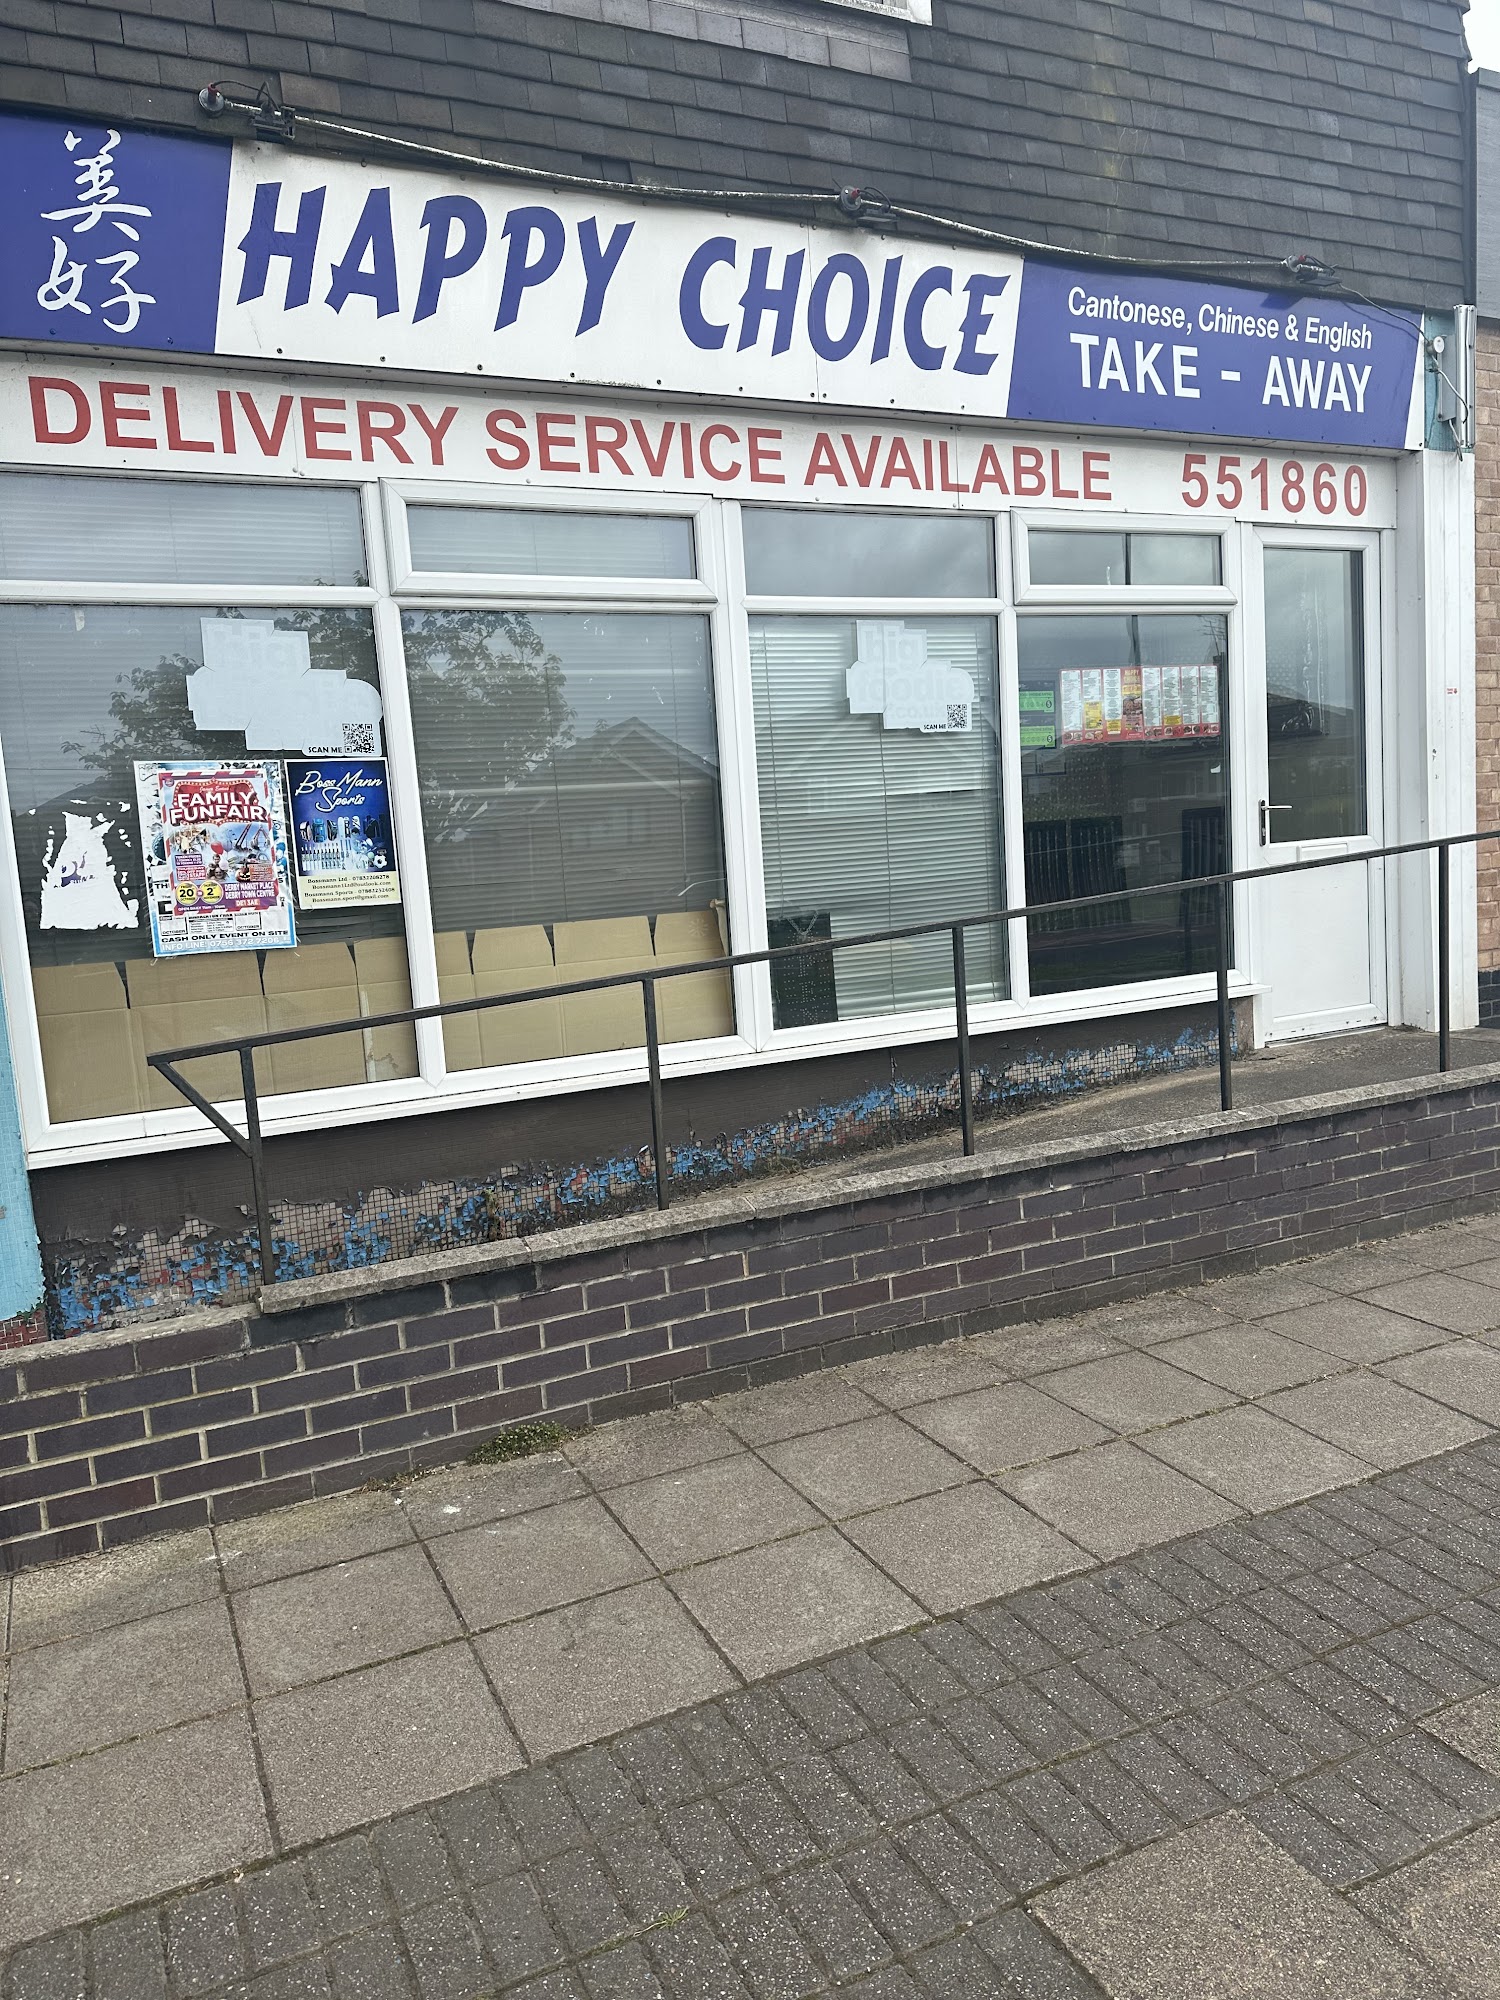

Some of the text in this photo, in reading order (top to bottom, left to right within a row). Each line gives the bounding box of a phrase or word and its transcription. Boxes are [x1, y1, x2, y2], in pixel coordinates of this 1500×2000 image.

[236, 181, 1011, 376] HAPPY CHOICE
[1068, 286, 1372, 353] Cantonese, Chinese & English
[1069, 332, 1201, 399] TAKE
[1261, 354, 1373, 413] AWAY
[27, 375, 1112, 501] DELIVERY SERVICE AVAILABLE
[1181, 453, 1368, 517] 551860
[308, 746, 343, 754] SCAN ME
[295, 769, 383, 796] Boss Mann
[177, 791, 255, 808] FAMILY
[315, 786, 366, 812] Sports
[170, 804, 268, 825] FUNFAIR
[179, 888, 194, 898] 20
[206, 887, 213, 895] 2
[240, 882, 259, 890] MARKET
[259, 881, 275, 889] PLACE
[241, 890, 256, 898] TOWN
[257, 889, 275, 898] CENTRE
[161, 935, 189, 943] CASH
[209, 939, 234, 947] 0756
